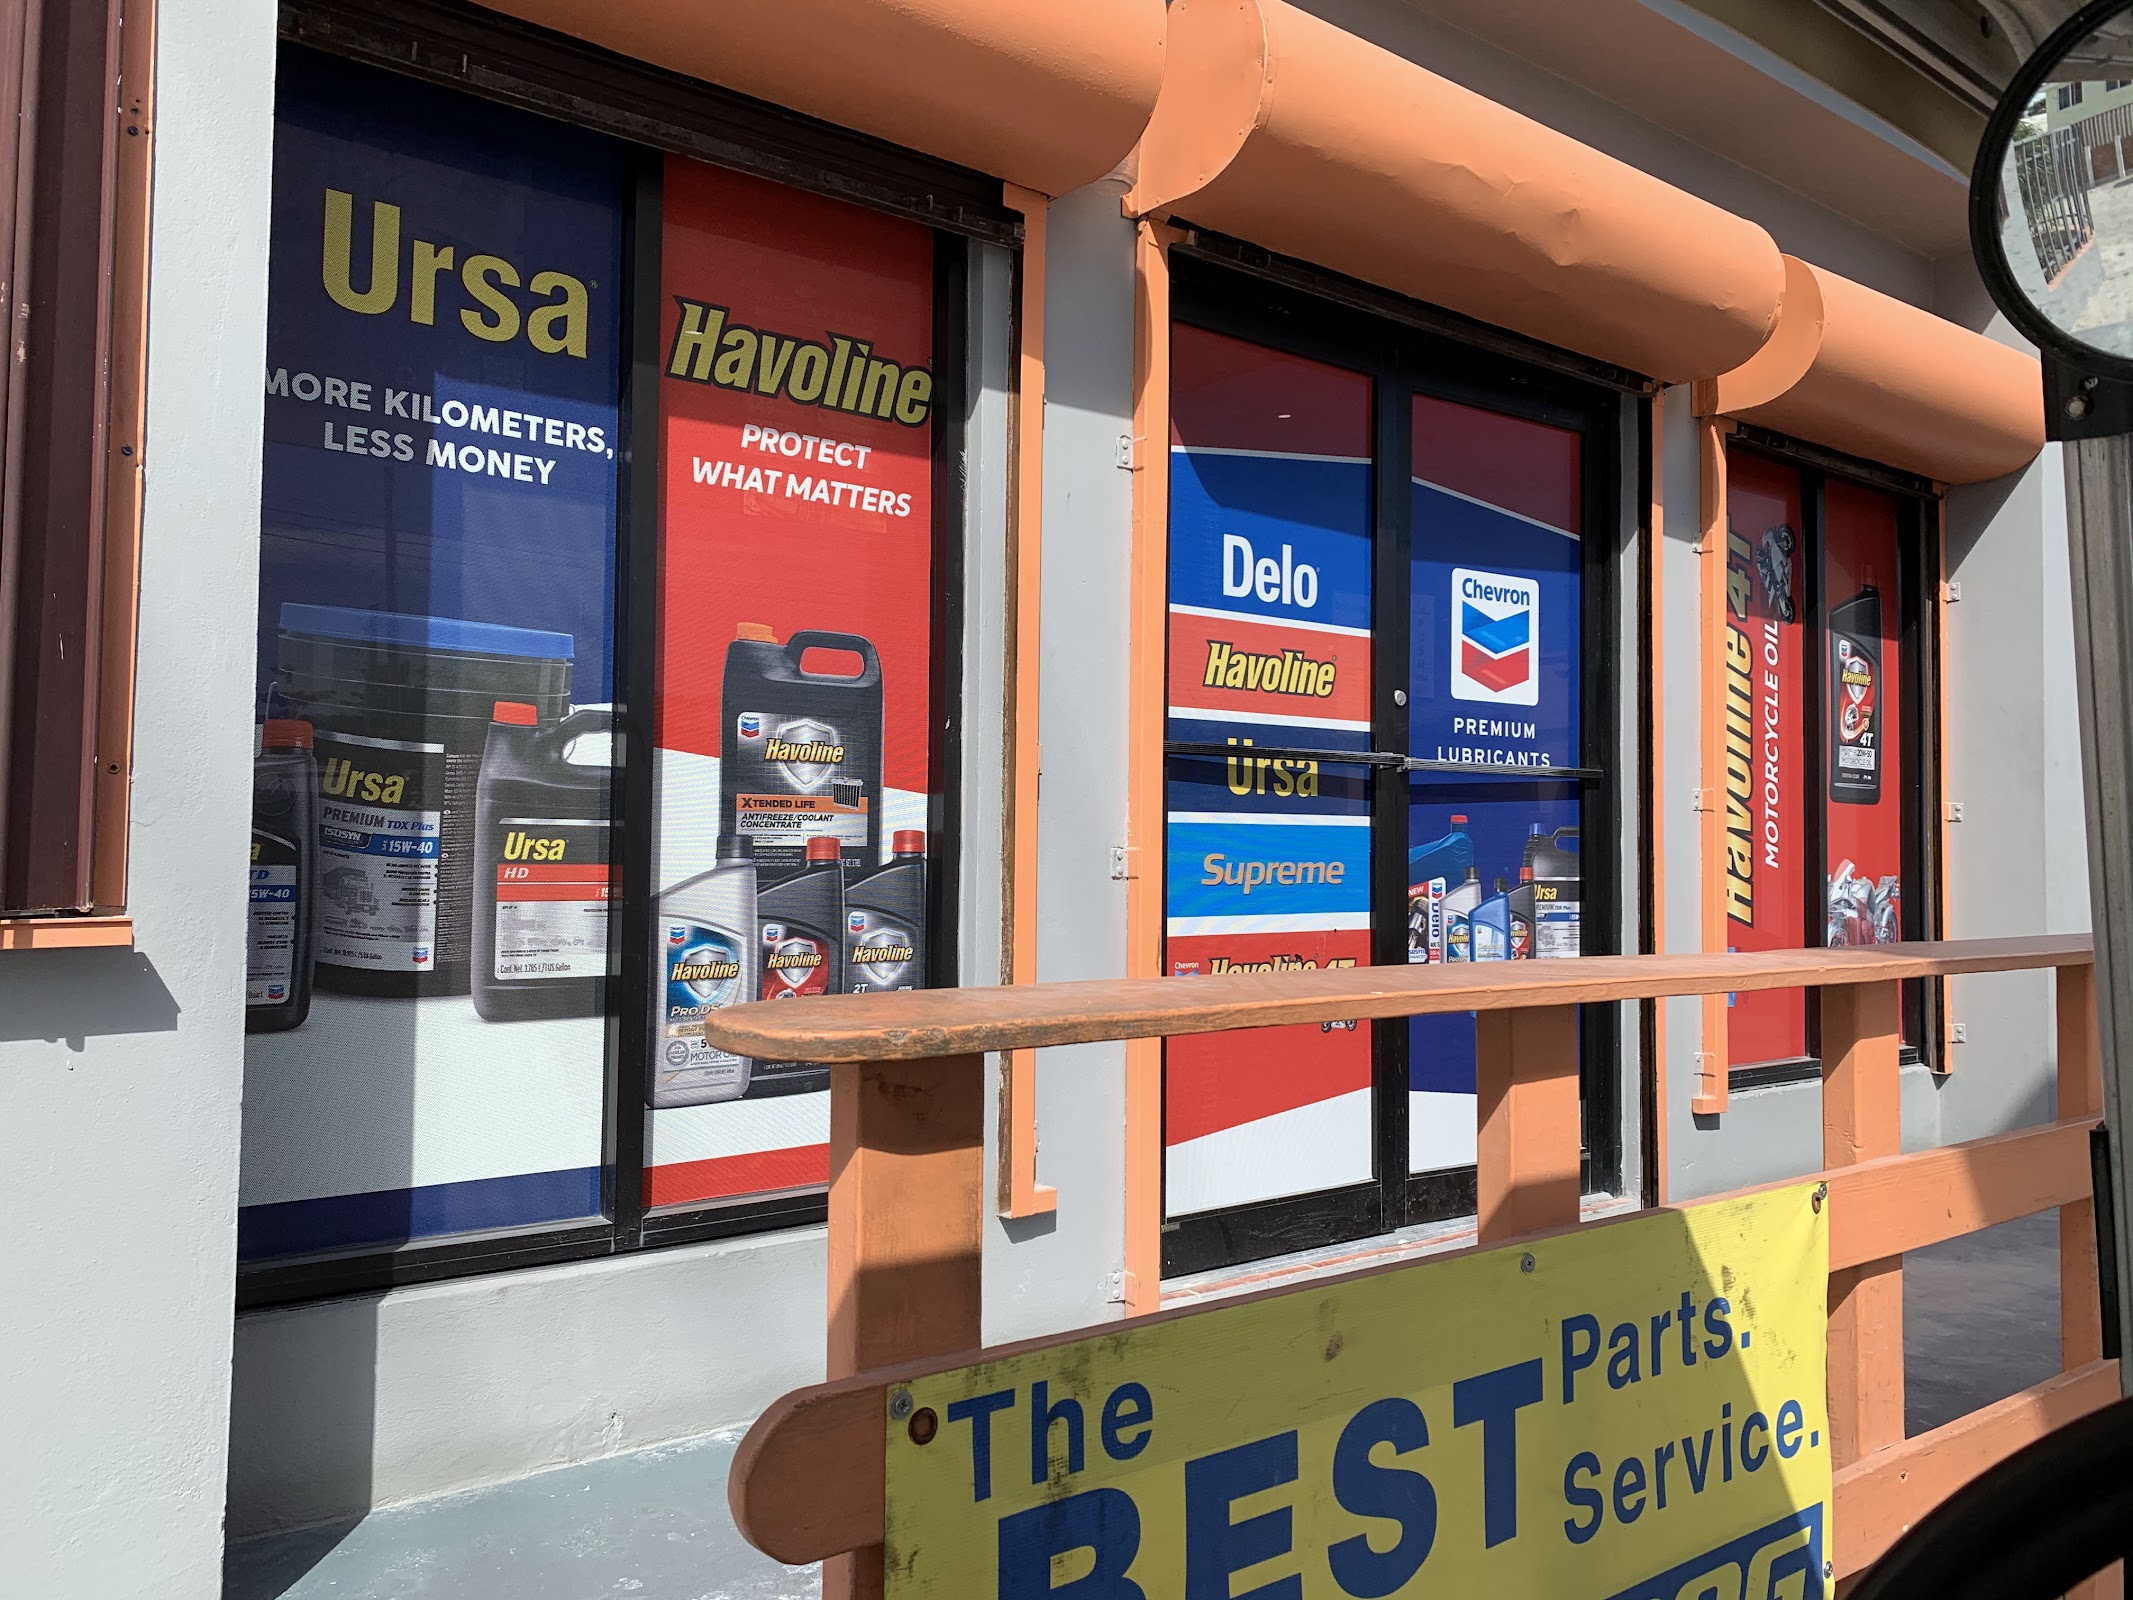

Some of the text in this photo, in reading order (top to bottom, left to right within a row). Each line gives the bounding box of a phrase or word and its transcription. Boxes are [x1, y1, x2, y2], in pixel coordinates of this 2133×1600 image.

[323, 188, 592, 360] Ursa
[665, 295, 935, 428] Havoline
[265, 366, 614, 461] MORE KILOMETERS,
[323, 421, 557, 486] LESS MONEY
[741, 423, 872, 470] PROTECT
[691, 455, 913, 519] WHAT MATTERS
[1222, 533, 1319, 608] Delo
[1461, 577, 1531, 606] Chevron
[1202, 638, 1338, 699] Havoline
[1841, 668, 1873, 688] Havoline
[1453, 717, 1537, 740] PREMIUM
[1859, 732, 1874, 747] 4T
[765, 737, 845, 764] Havoline
[1437, 746, 1551, 768] LUBRICANTS
[1765, 620, 1780, 869] MOTORCYCLE OIL
[1227, 737, 1320, 798] Ursa
[322, 757, 406, 804] Ursa
[741, 797, 816, 809] XTENDED LIFE
[323, 806, 434, 831] PREMIUM TDX Plus
[740, 820, 803, 829] CONCENTRATE
[741, 813, 835, 822] ANTIFREEZE/COOLANT
[388, 840, 434, 854] 15W-40
[503, 831, 567, 861] Ursa
[503, 867, 530, 879] HD
[1201, 853, 1346, 895] Supreme
[250, 888, 291, 899] 5W-40
[1408, 886, 1425, 897] NEW
[1534, 884, 1558, 900] Ursa
[766, 952, 823, 970] Havoline
[851, 944, 914, 964] Havoline
[1174, 961, 1200, 970] Chevron
[671, 960, 740, 982] Havoline
[852, 983, 869, 994] 2T
[690, 1050, 722, 1062] MOTOR
[1560, 1290, 1752, 1405] Parts.
[946, 1379, 1154, 1503] The
[1562, 1397, 1820, 1545] Service.
